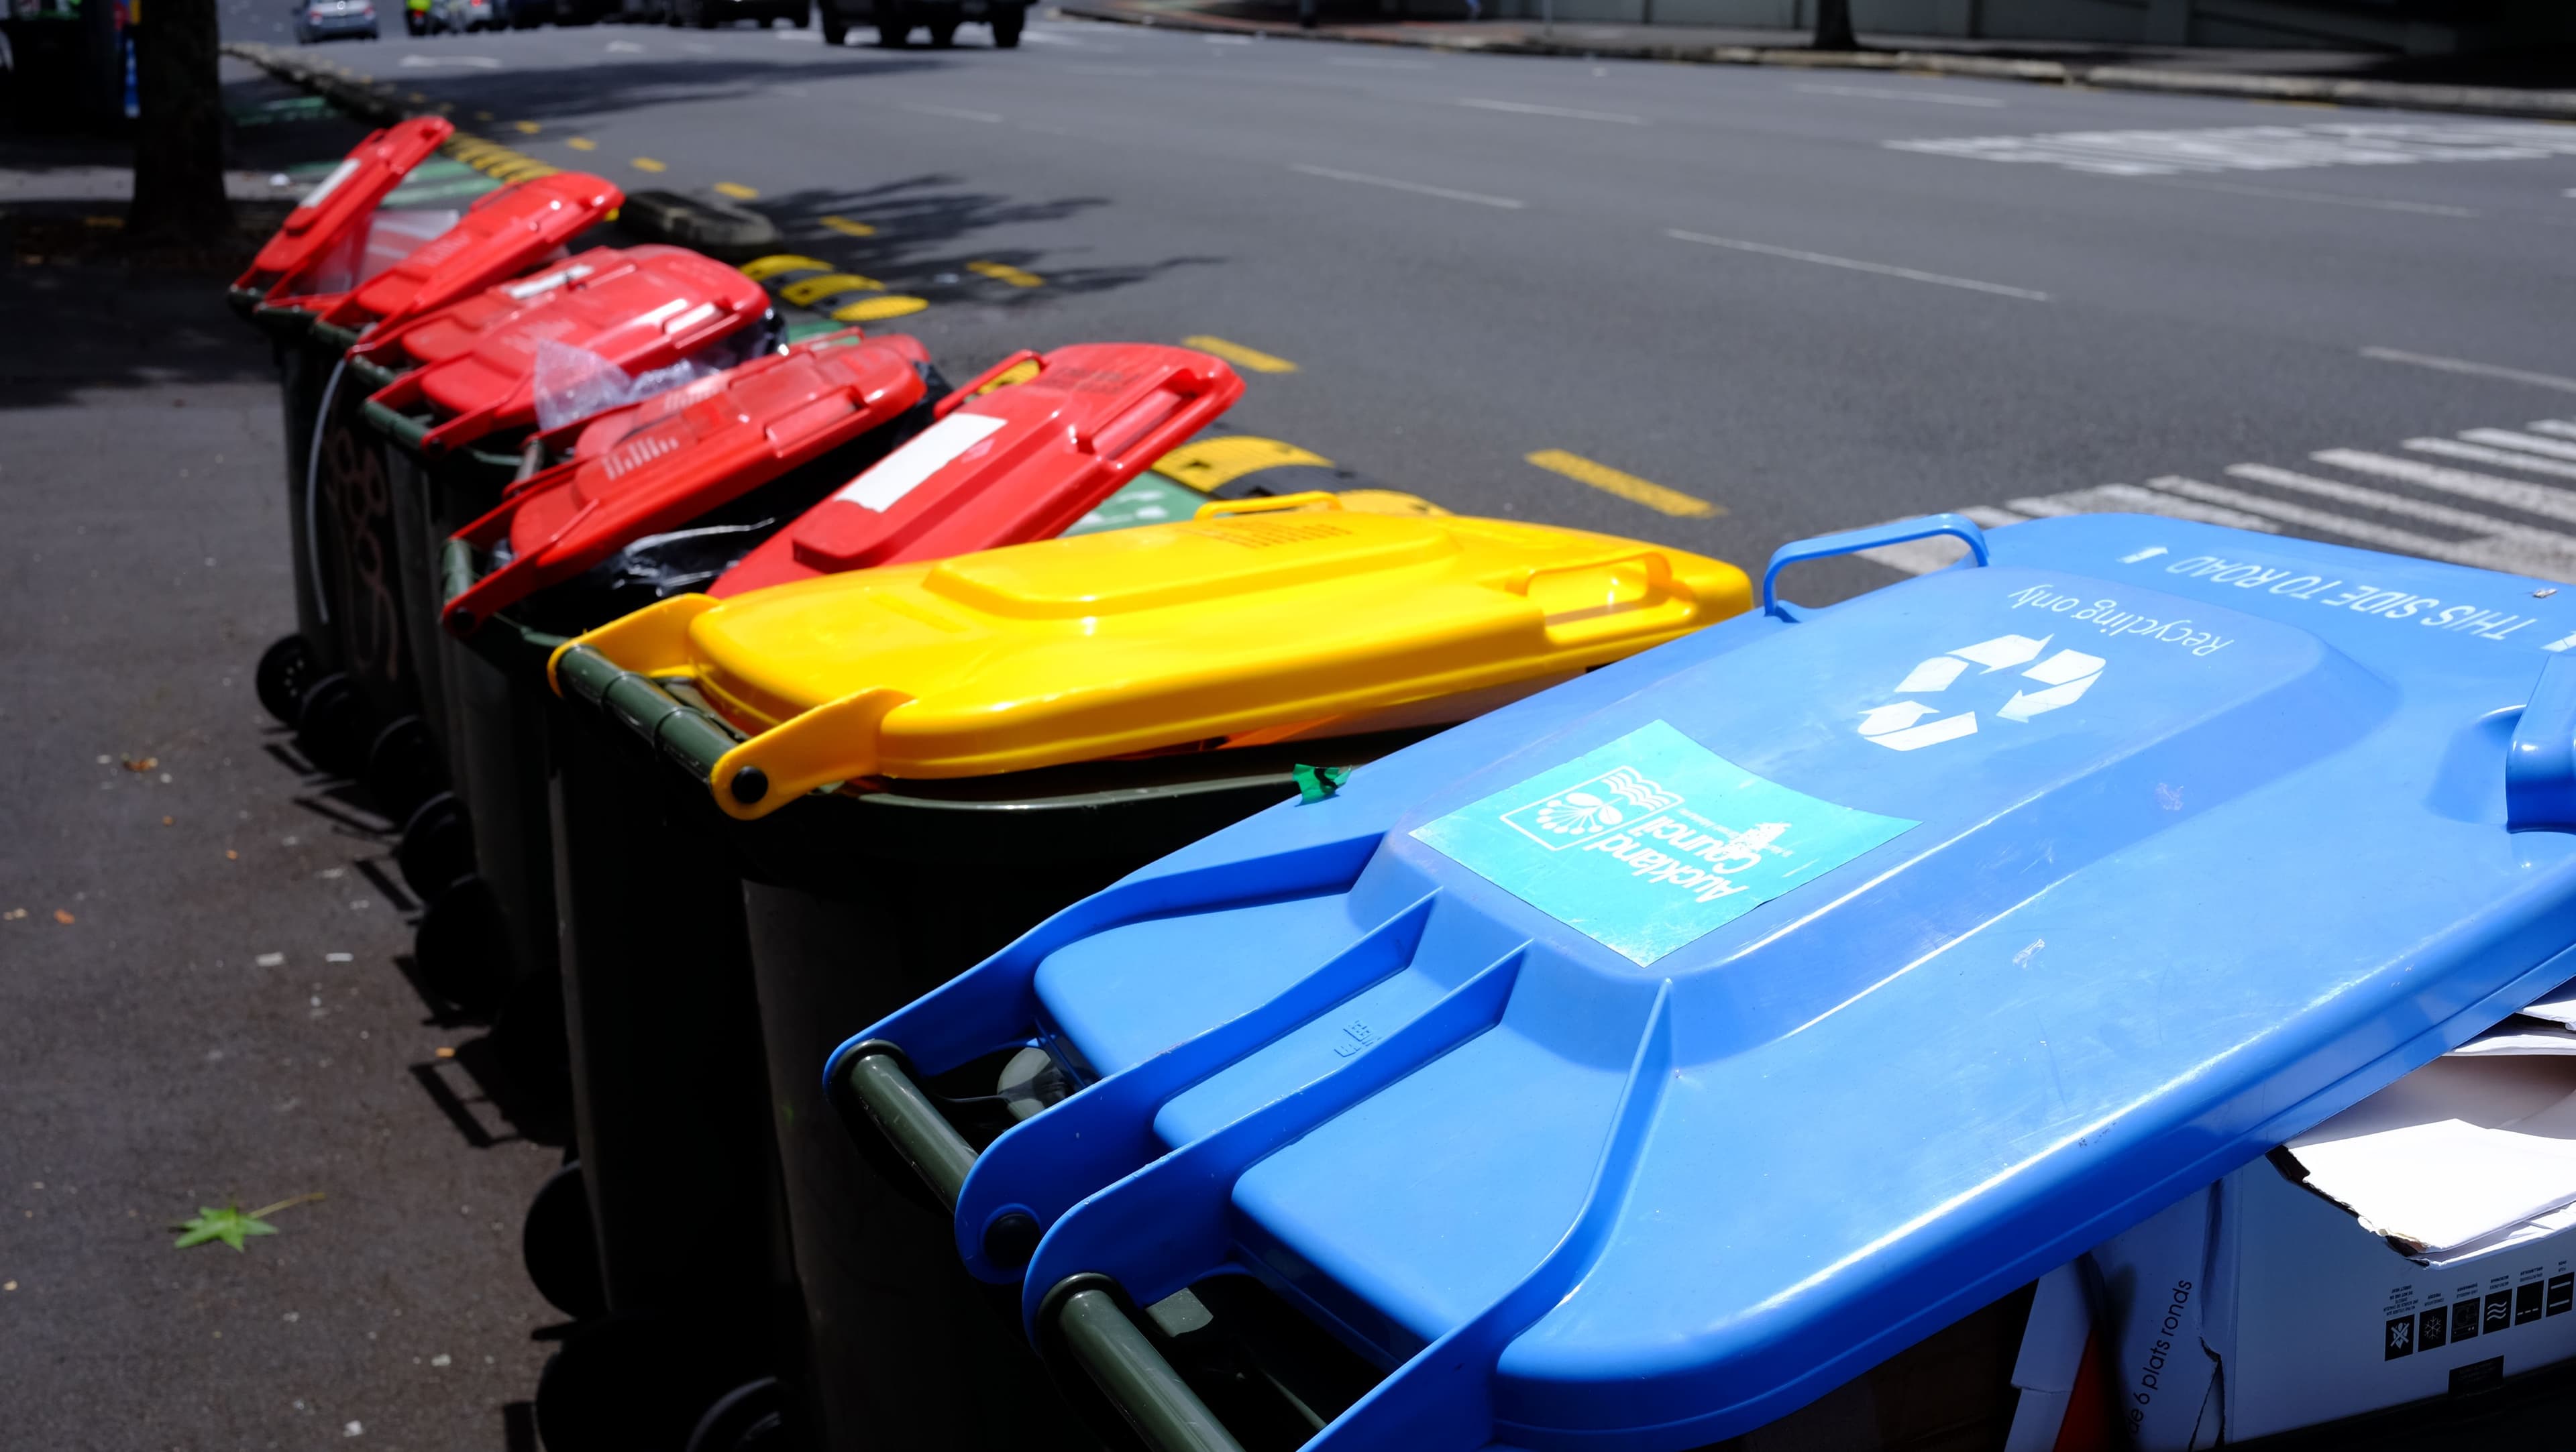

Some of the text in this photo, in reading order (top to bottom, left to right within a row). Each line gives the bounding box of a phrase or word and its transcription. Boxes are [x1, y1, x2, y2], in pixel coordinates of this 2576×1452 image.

[2007, 583, 2235, 657] Recycling only
[2165, 556, 2538, 640] THIS SIDE TO ROAD
[1582, 833, 1750, 903] Auckland
[1627, 815, 1762, 875] Council
[2161, 1279, 2192, 1337] ronds
[2141, 1339, 2171, 1391] plats
[2133, 1391, 2151, 1406] 6
